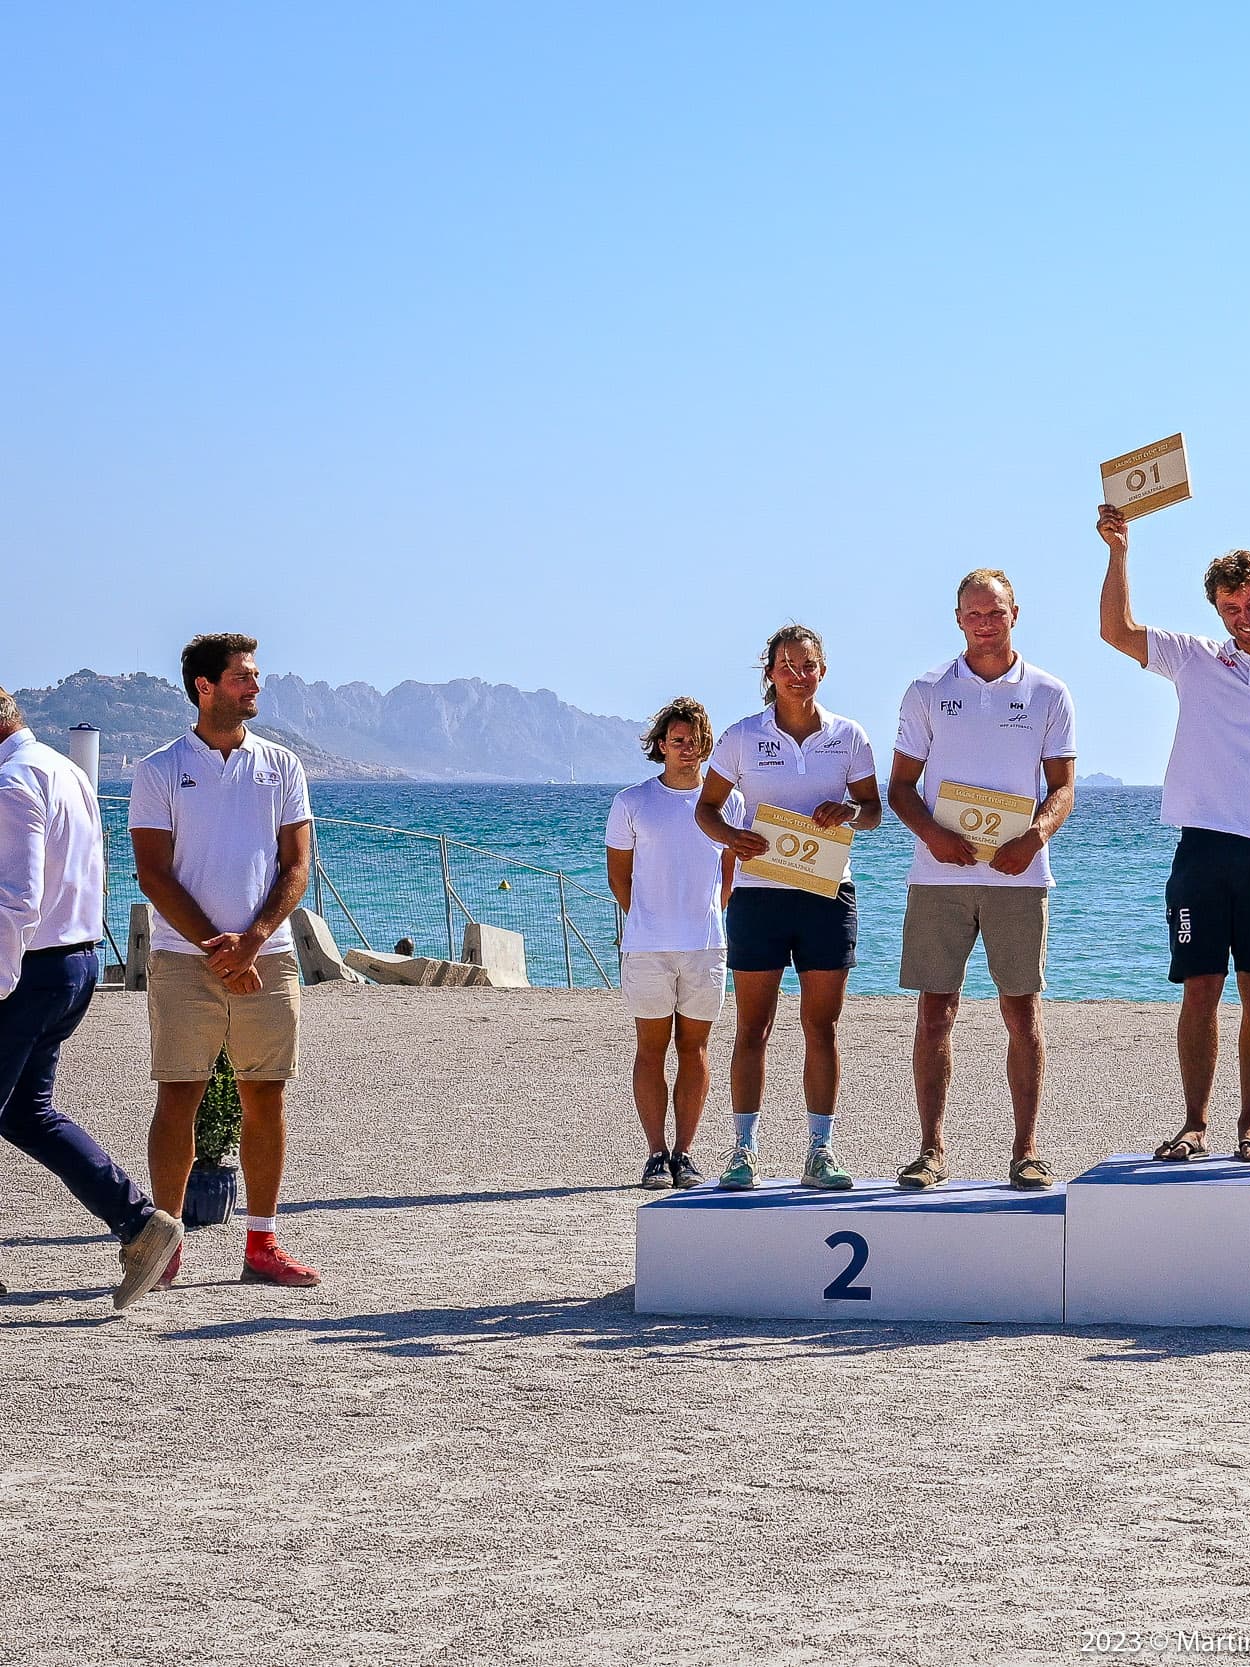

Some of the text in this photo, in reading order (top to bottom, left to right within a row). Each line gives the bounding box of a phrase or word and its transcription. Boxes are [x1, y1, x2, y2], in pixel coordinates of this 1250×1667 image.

[1126, 462, 1160, 492] 01
[960, 807, 1002, 837] 02
[776, 834, 820, 865] 02
[1178, 908, 1192, 944] Slam
[824, 1230, 872, 1300] 2
